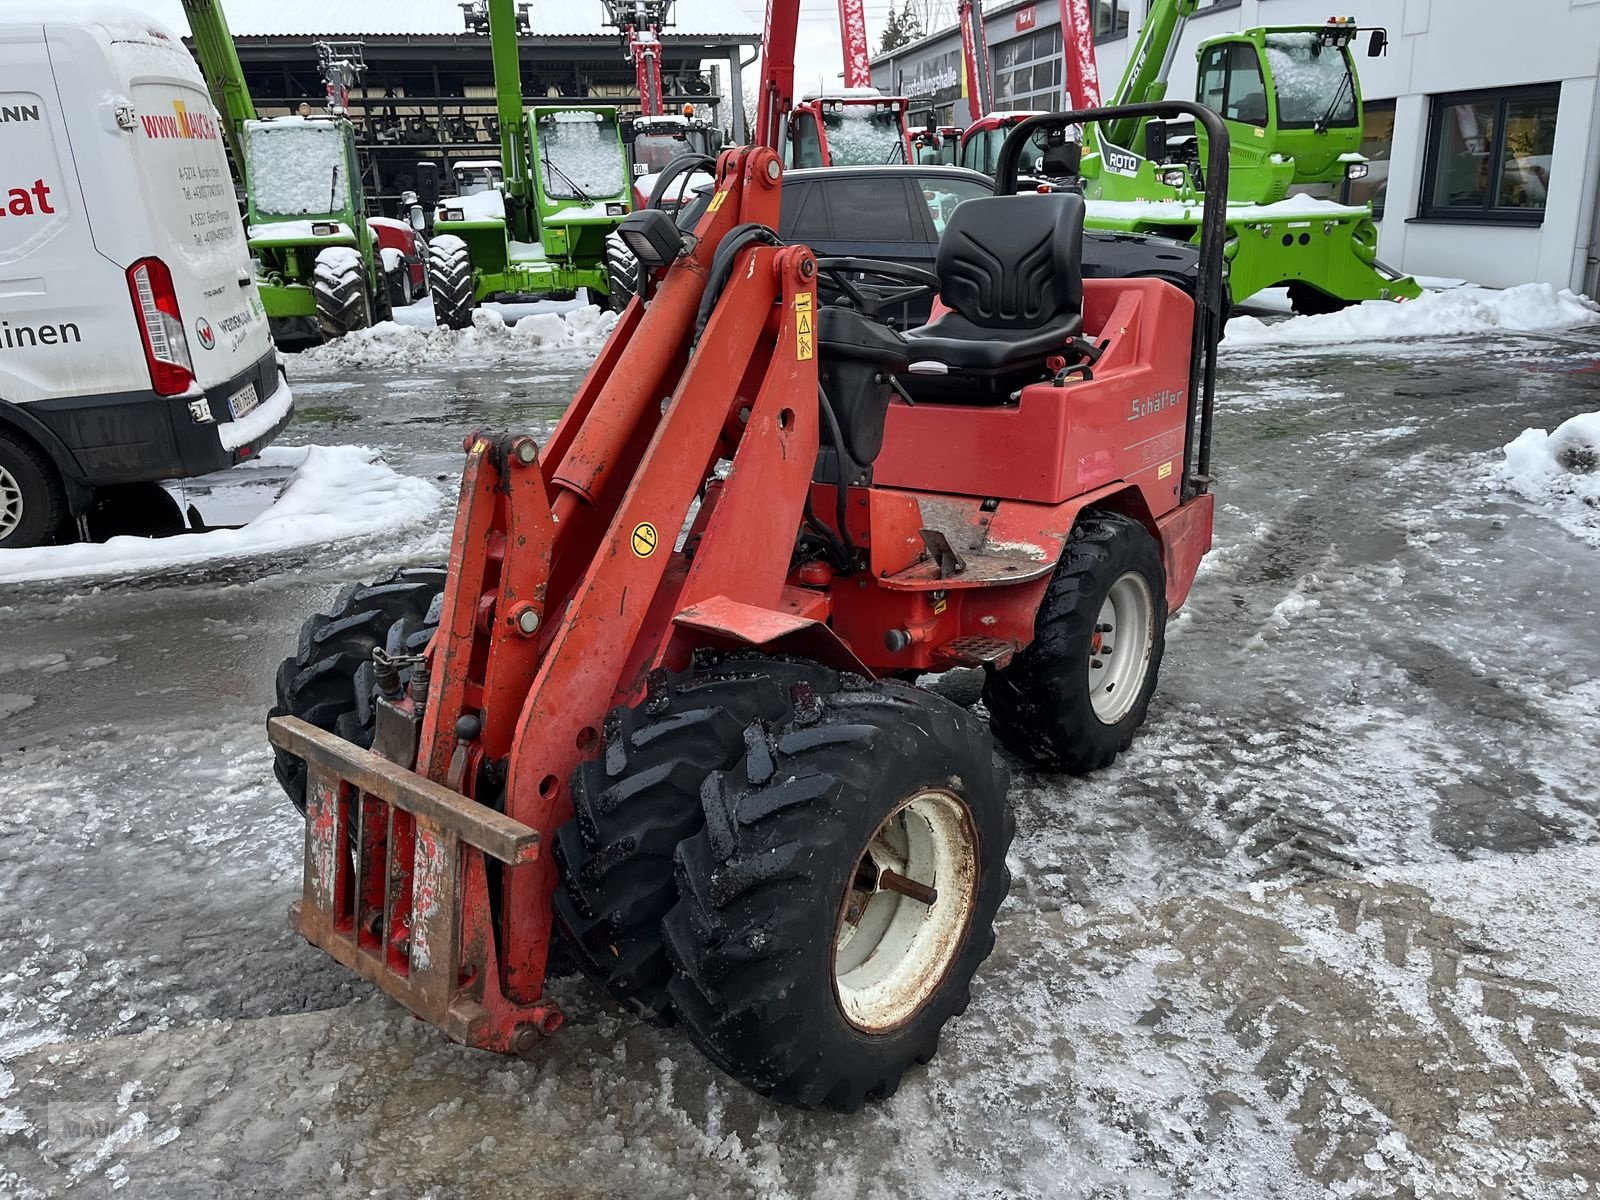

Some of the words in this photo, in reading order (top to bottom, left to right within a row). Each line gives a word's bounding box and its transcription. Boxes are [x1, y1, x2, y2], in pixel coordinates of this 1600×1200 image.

[0, 105, 40, 122] NN
[634, 165, 643, 174] 30
[1110, 153, 1137, 170] ROTO
[0, 320, 82, 349] inen
